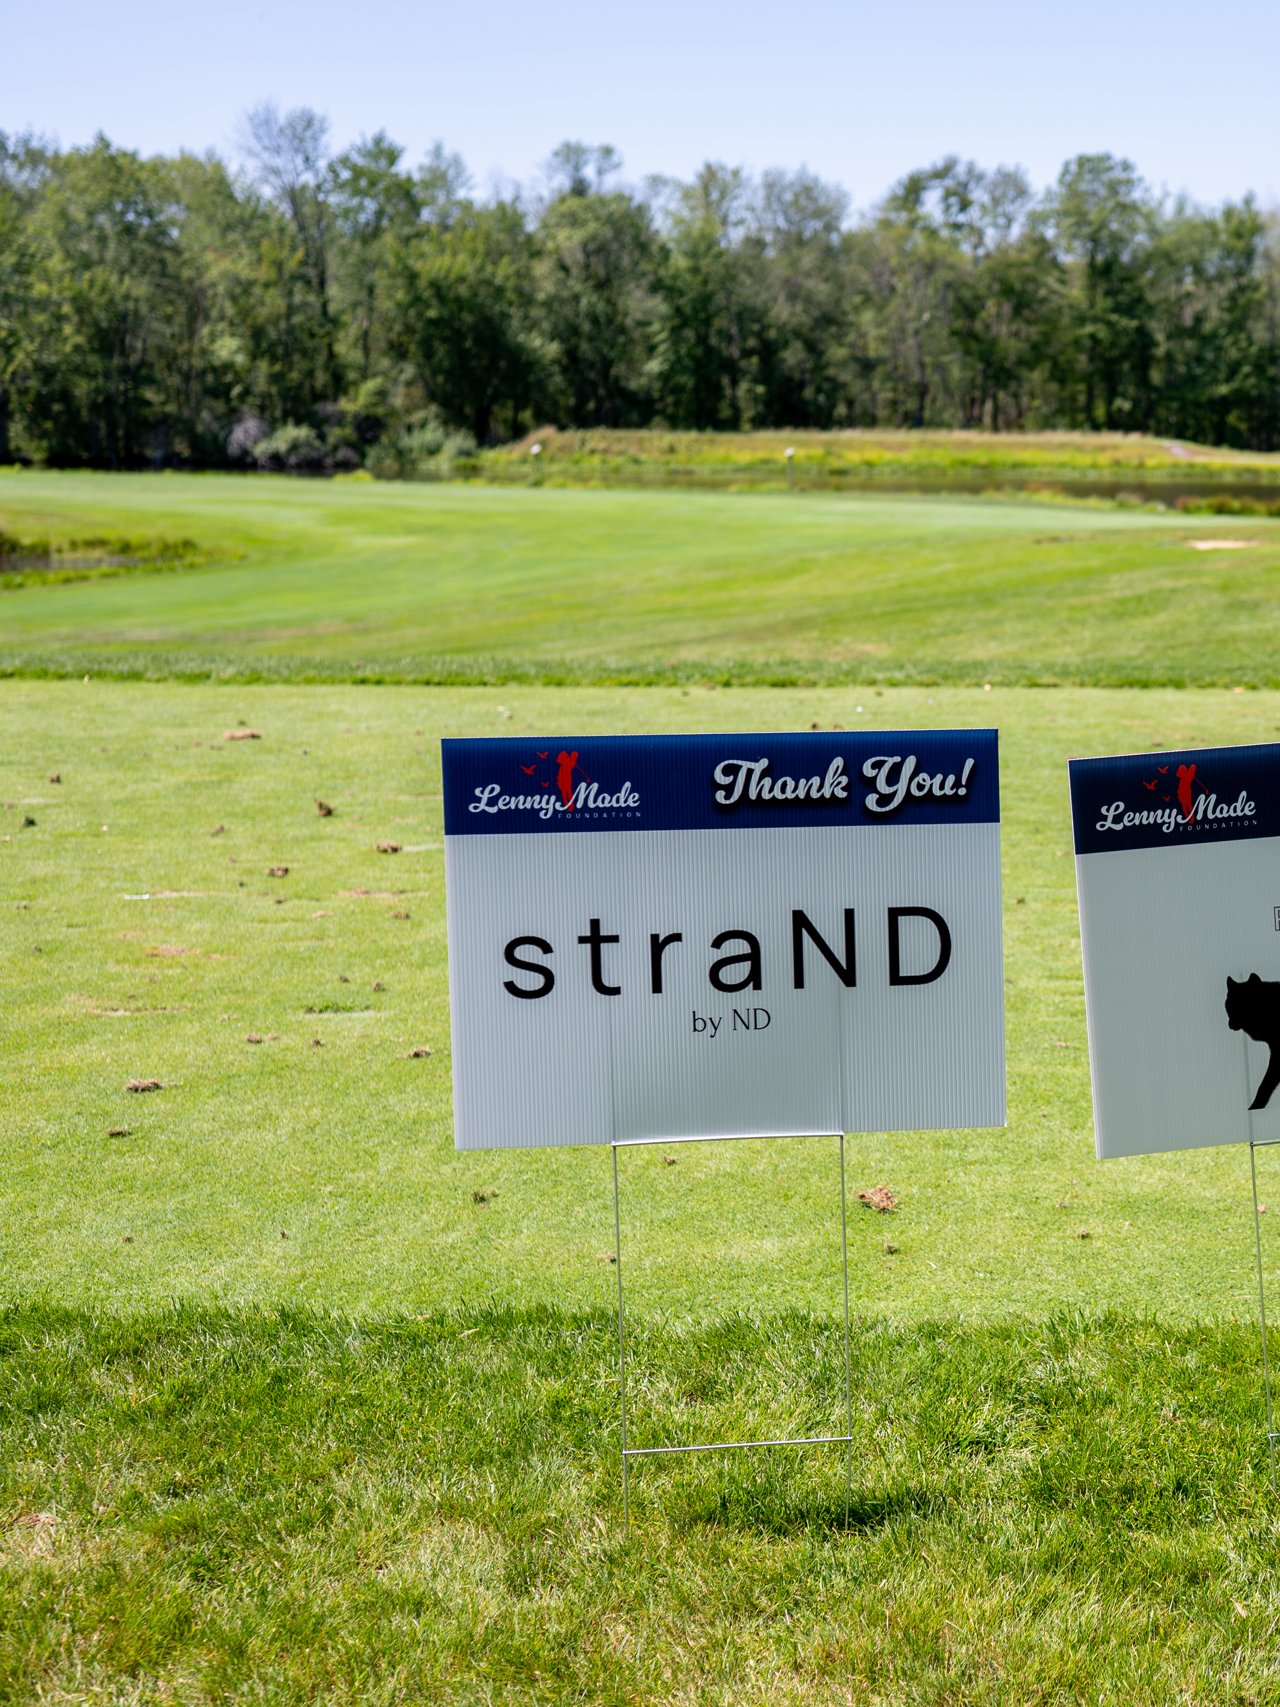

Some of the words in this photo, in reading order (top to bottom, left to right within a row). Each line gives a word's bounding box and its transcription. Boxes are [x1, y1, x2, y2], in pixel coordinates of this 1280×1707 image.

[713, 756, 848, 804] Thank
[862, 755, 975, 812] You!
[1180, 820, 1257, 831] FOUNDATION
[503, 905, 952, 999] straND
[691, 1010, 723, 1038] by
[732, 1007, 771, 1031] ND
